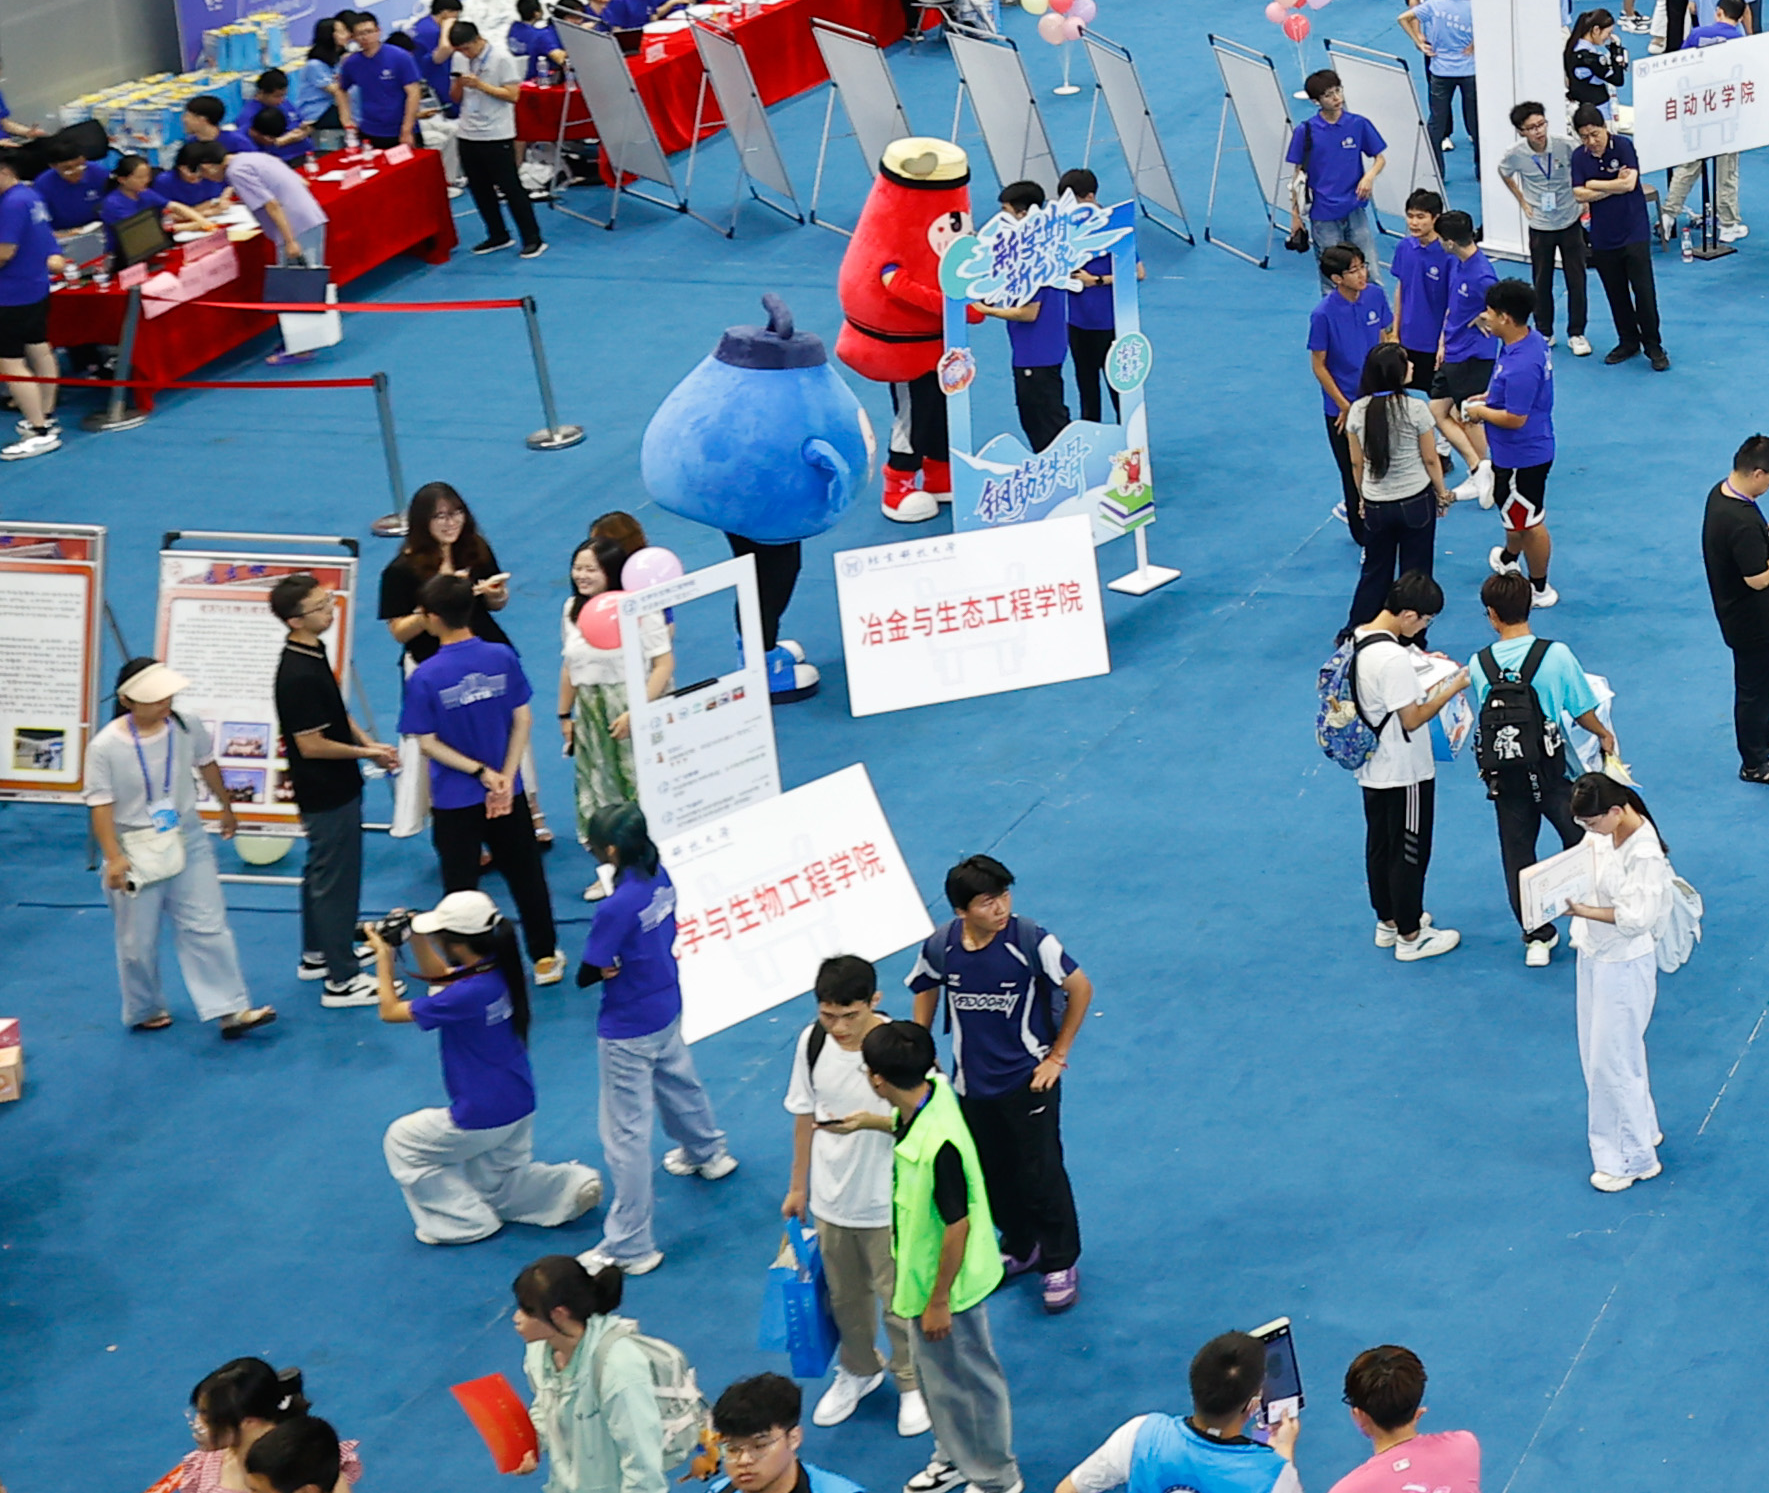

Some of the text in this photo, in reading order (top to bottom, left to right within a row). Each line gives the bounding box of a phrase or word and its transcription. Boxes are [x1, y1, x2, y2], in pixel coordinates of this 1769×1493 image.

[1664, 81, 1756, 123] 自动化学院
[859, 579, 1084, 647] 冶金与生态工程学院
